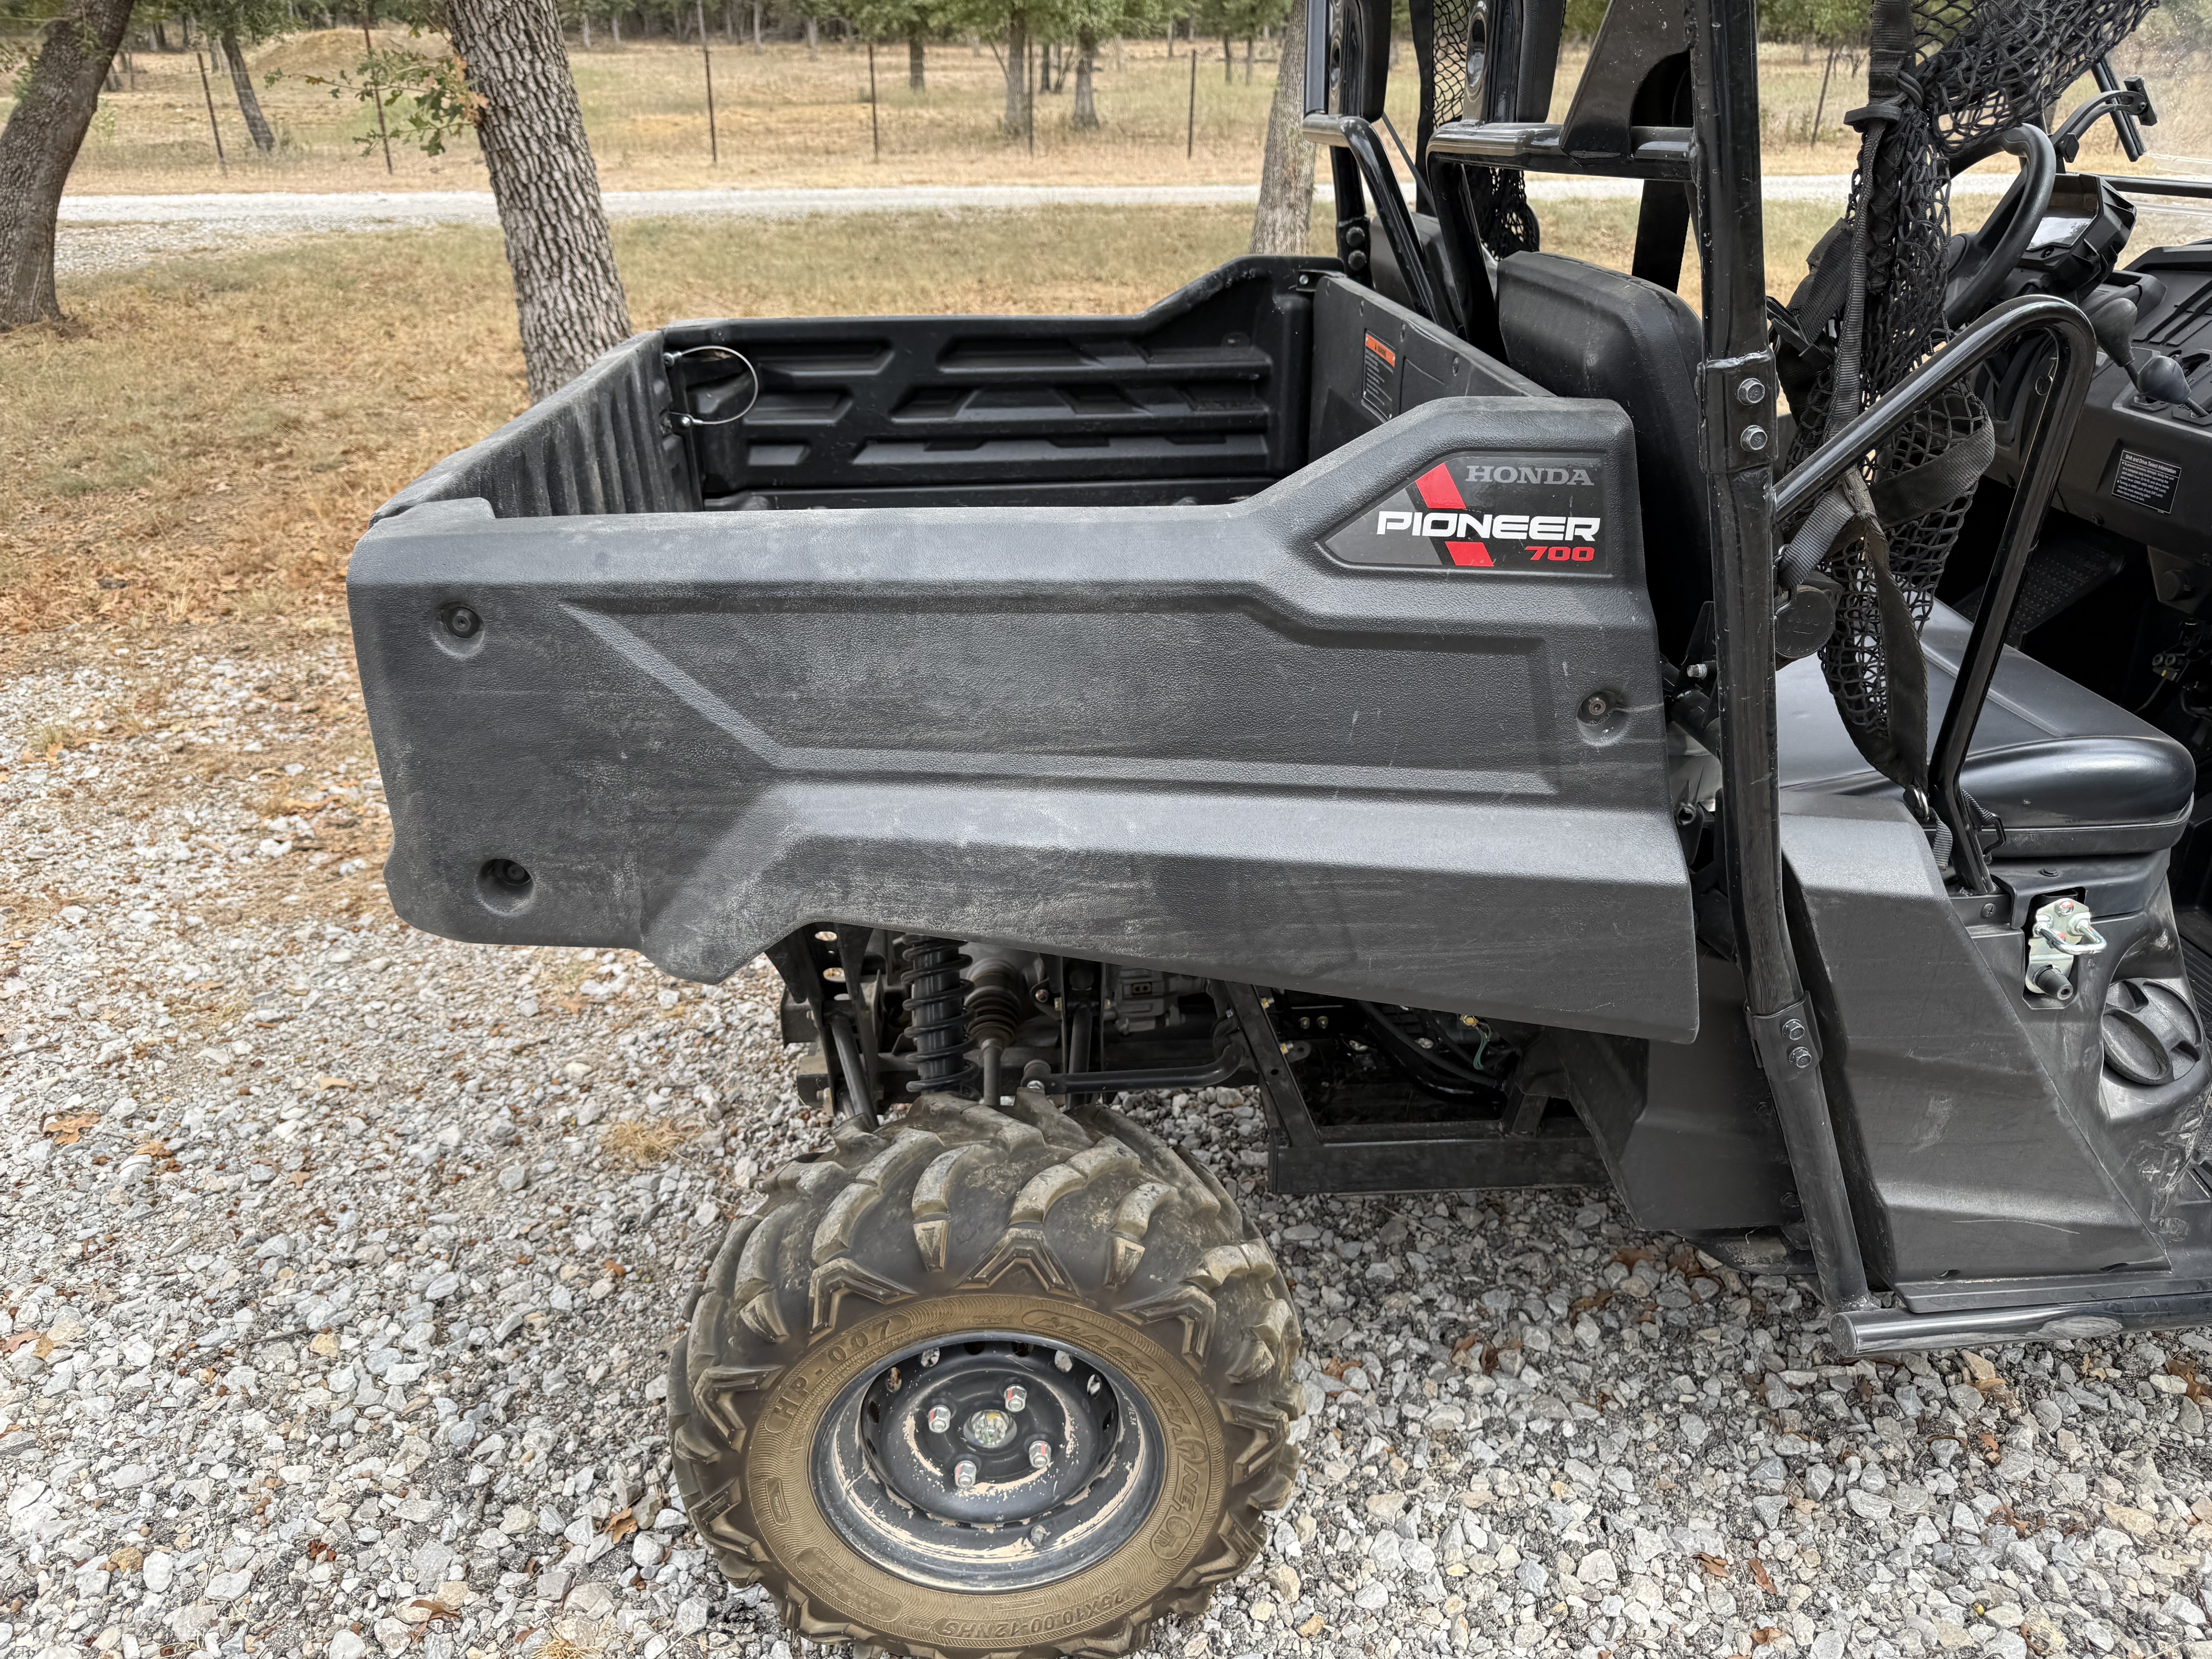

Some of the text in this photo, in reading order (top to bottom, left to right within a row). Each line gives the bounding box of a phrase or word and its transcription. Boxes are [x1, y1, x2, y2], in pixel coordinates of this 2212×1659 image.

[1465, 465, 1595, 486] HONDA
[2157, 464, 2176, 474] Information
[1376, 510, 1601, 542] PIONEER
[1524, 546, 1595, 562] 700
